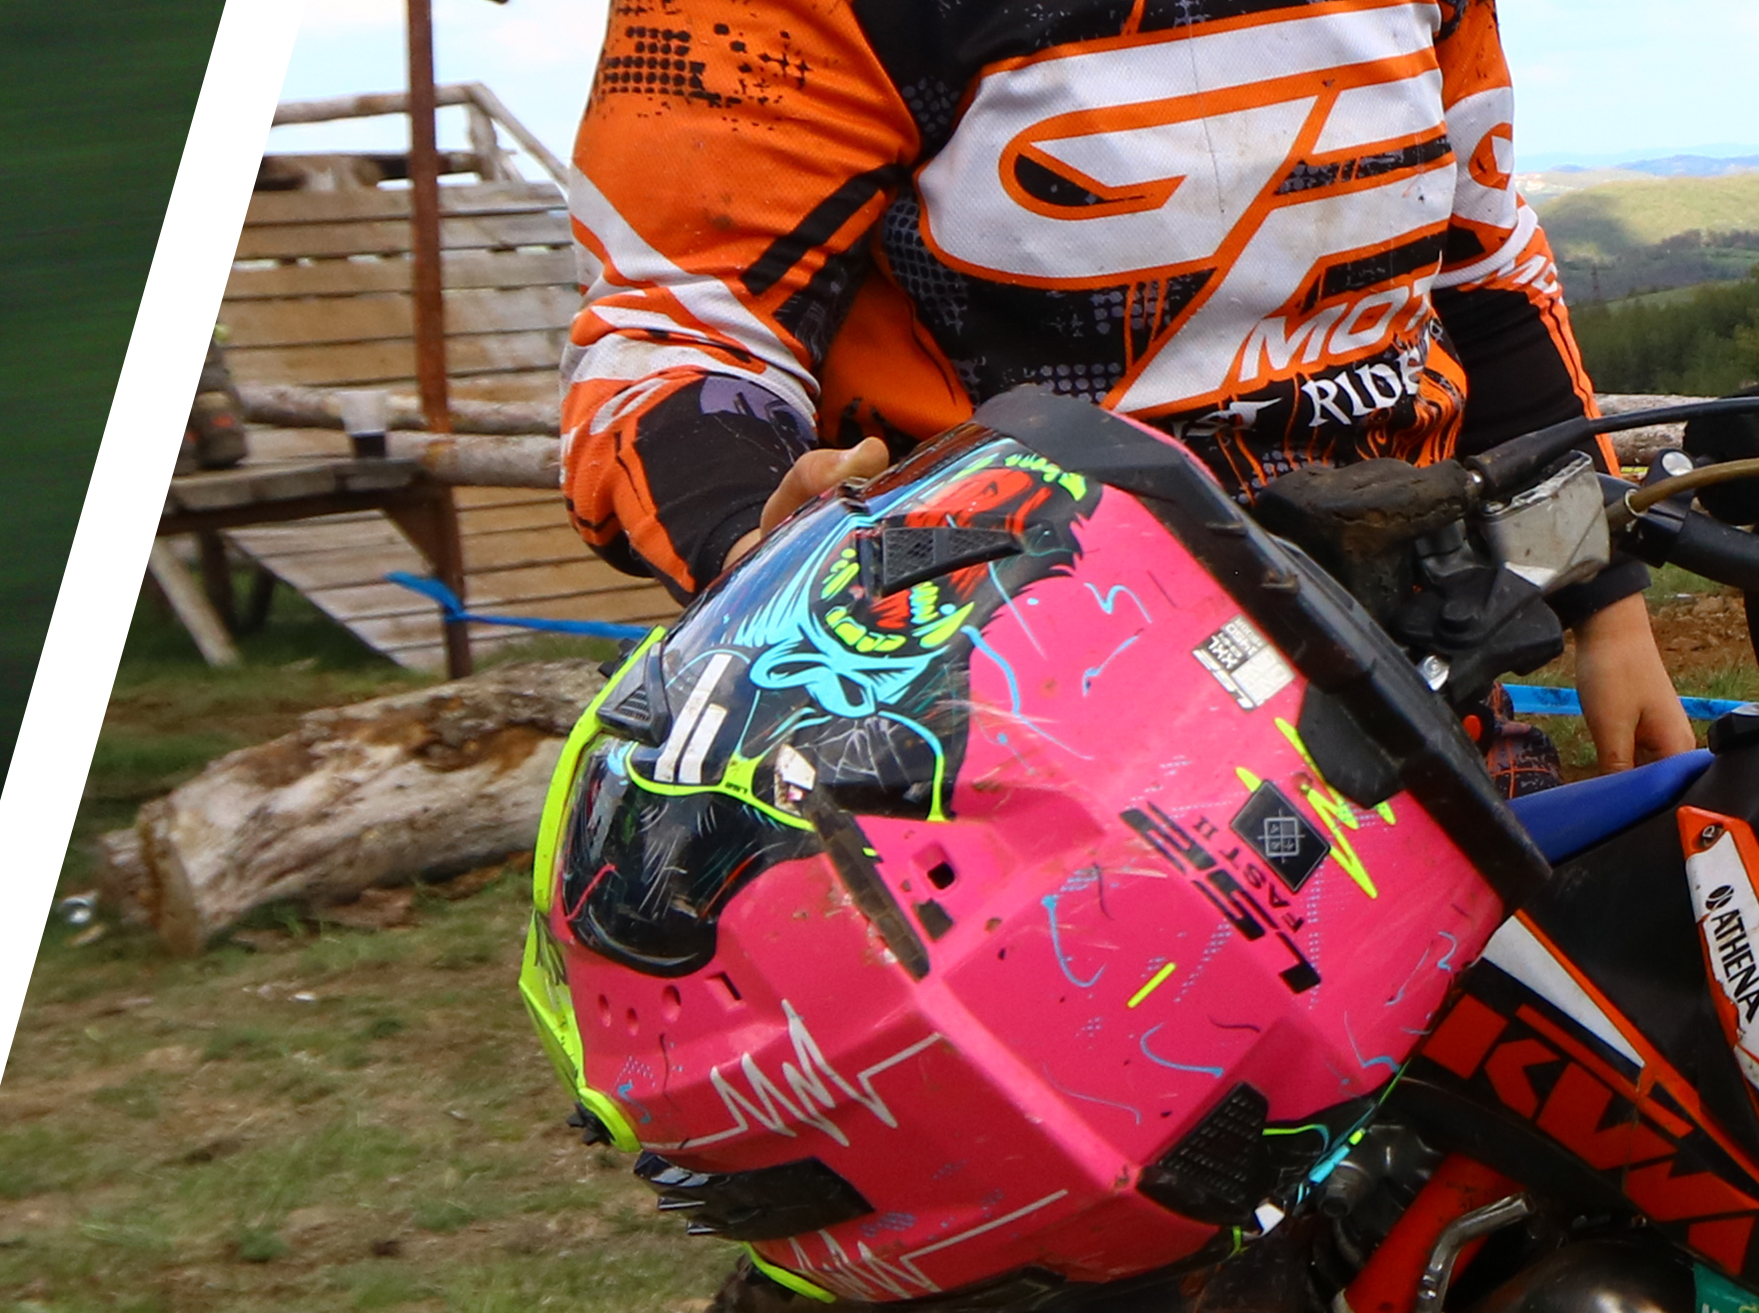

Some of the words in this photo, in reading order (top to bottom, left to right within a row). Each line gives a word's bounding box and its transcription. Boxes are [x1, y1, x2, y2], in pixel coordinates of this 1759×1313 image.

[1238, 278, 1432, 383] MOT
[1120, 808, 1321, 994] LS2
[1219, 847, 1304, 932] FAST
